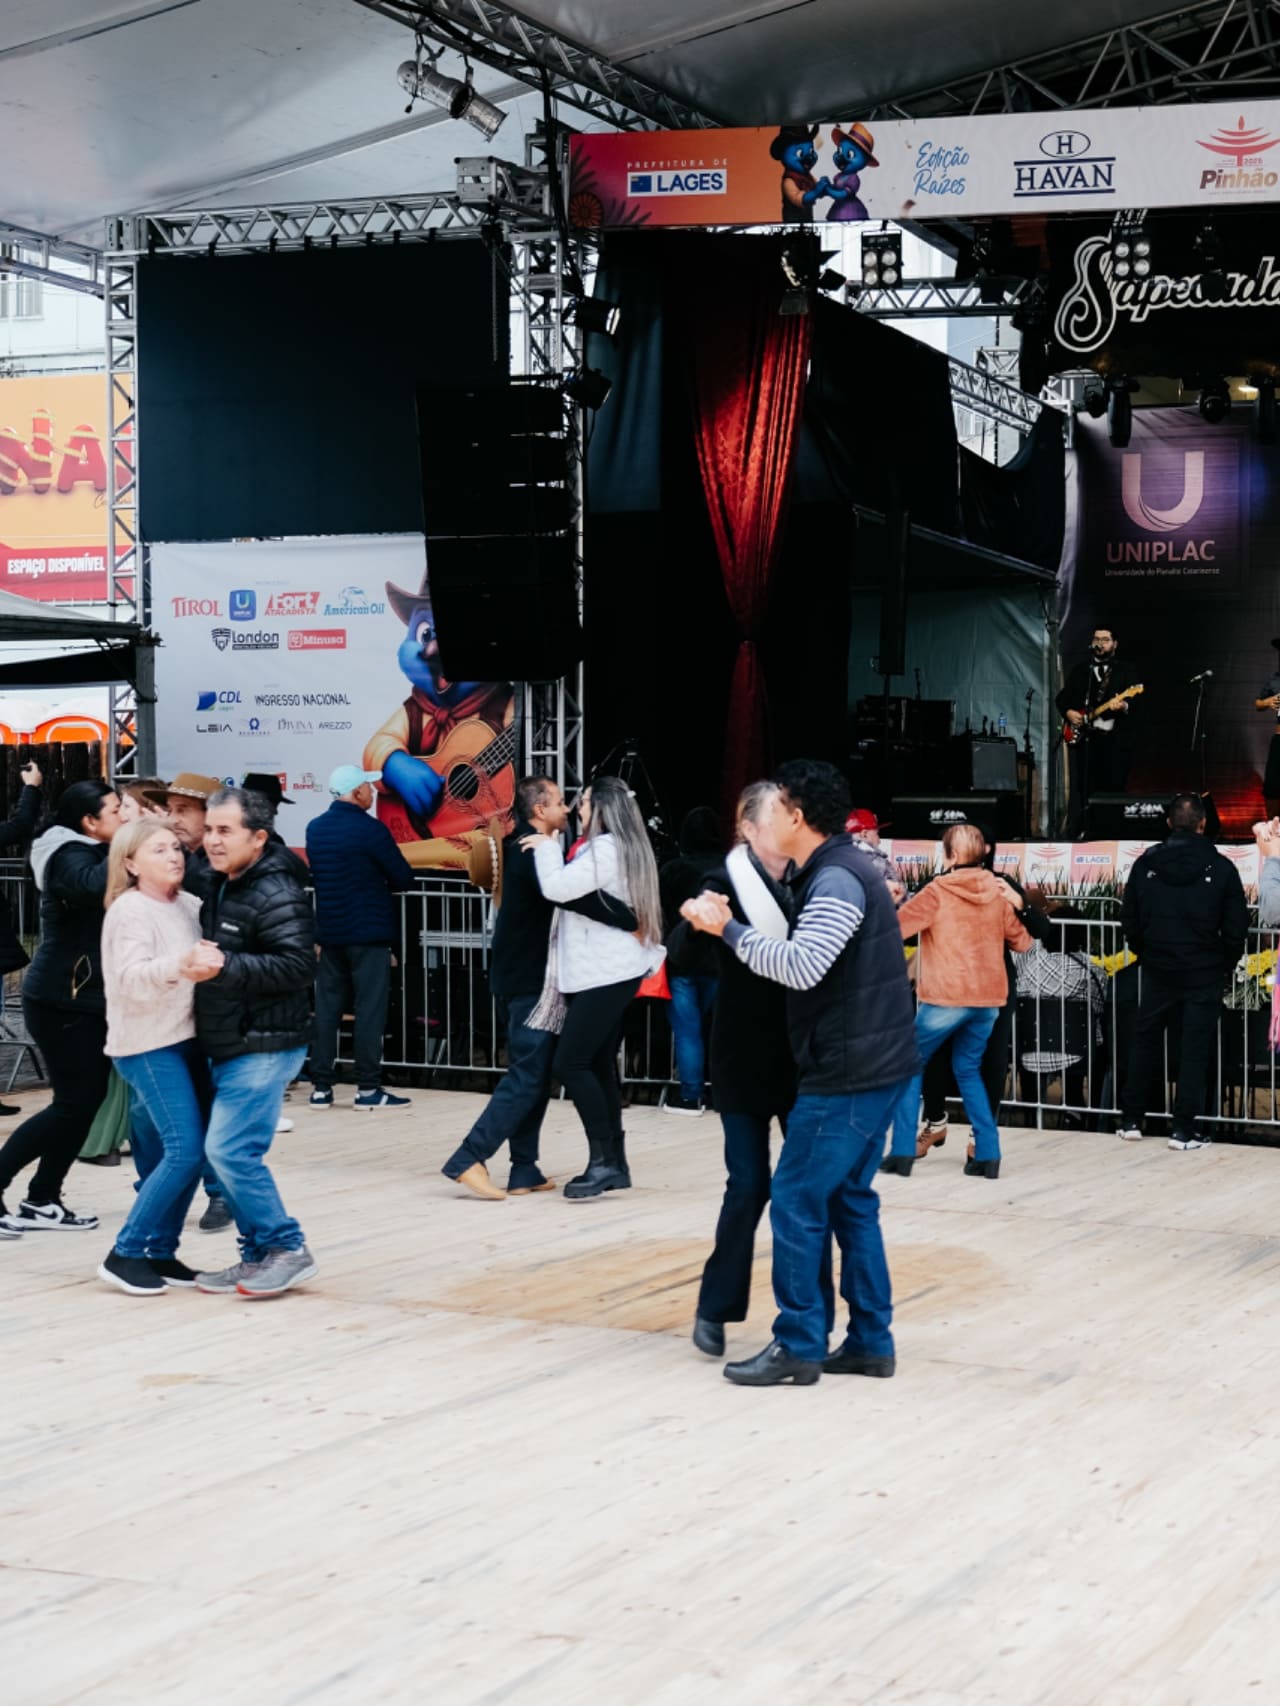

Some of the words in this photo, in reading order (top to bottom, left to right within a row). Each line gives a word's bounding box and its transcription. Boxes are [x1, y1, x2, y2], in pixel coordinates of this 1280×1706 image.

[1056, 134, 1074, 154] H
[627, 160, 704, 169] PREFEITURA
[713, 158, 728, 166] DE
[916, 141, 970, 172] Edição
[657, 173, 723, 192] LAGES
[913, 169, 967, 196] Raízes
[1015, 163, 1114, 191] HAVAN
[1200, 167, 1279, 189] Pinhão
[1107, 540, 1215, 562] UNIPLAC
[8, 558, 46, 578] ESPAÇO
[48, 552, 106, 572] DISPONÍVEL
[171, 597, 224, 618] TIROL
[264, 608, 317, 616] ATACADISTA
[324, 604, 369, 616] American
[370, 603, 385, 615] Oil
[303, 635, 344, 645] Minusa
[218, 691, 242, 703] CDL
[255, 694, 301, 707] INGRESSO
[302, 692, 352, 706] NACIONAL
[318, 721, 353, 730] AREZZO
